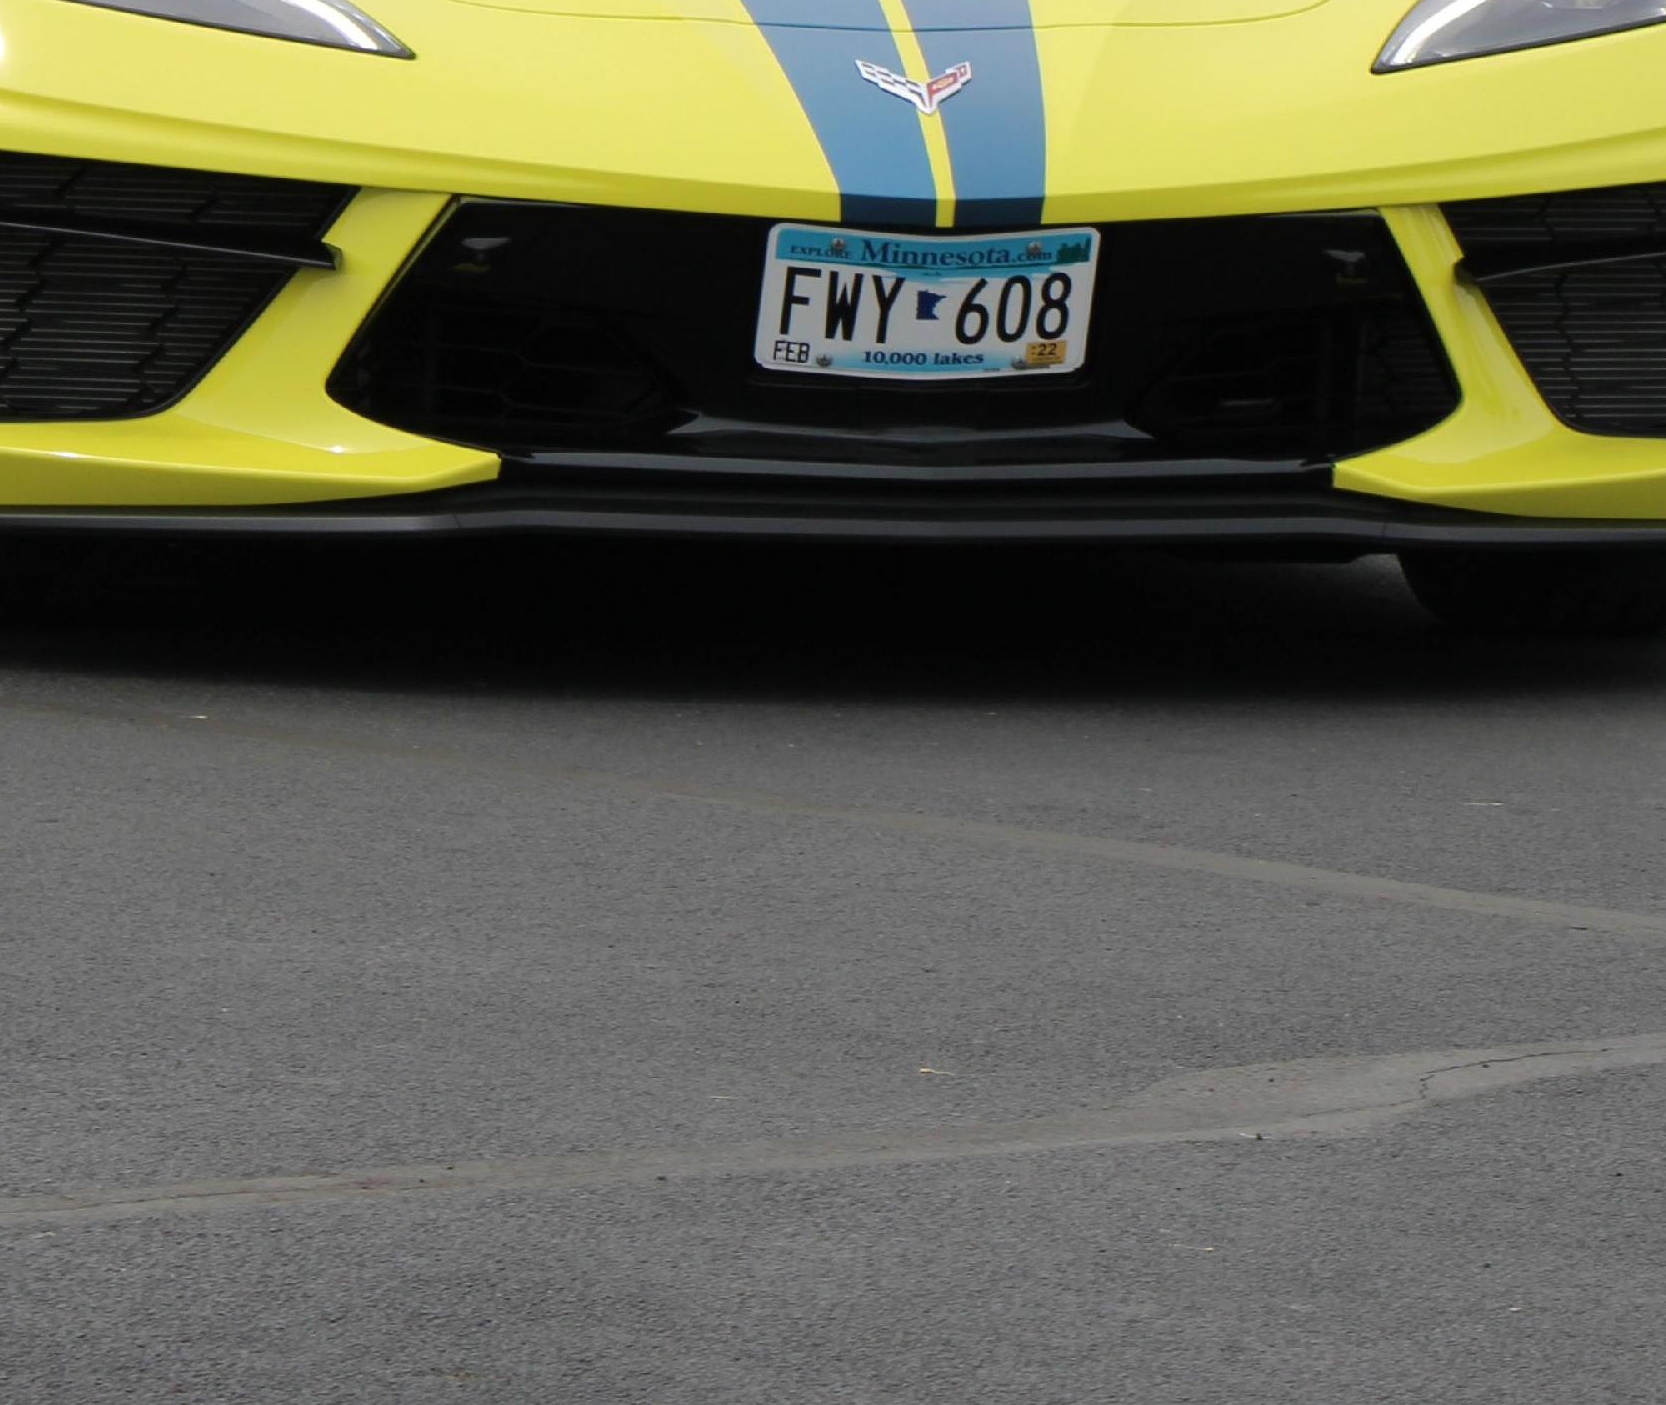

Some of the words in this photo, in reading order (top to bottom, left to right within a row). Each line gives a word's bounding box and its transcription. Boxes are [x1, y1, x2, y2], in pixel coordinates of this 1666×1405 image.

[780, 266, 906, 344] FWY
[955, 272, 1073, 345] 608
[773, 340, 811, 364] FEB
[864, 350, 927, 366] 10,000
[933, 352, 985, 366] lakes
